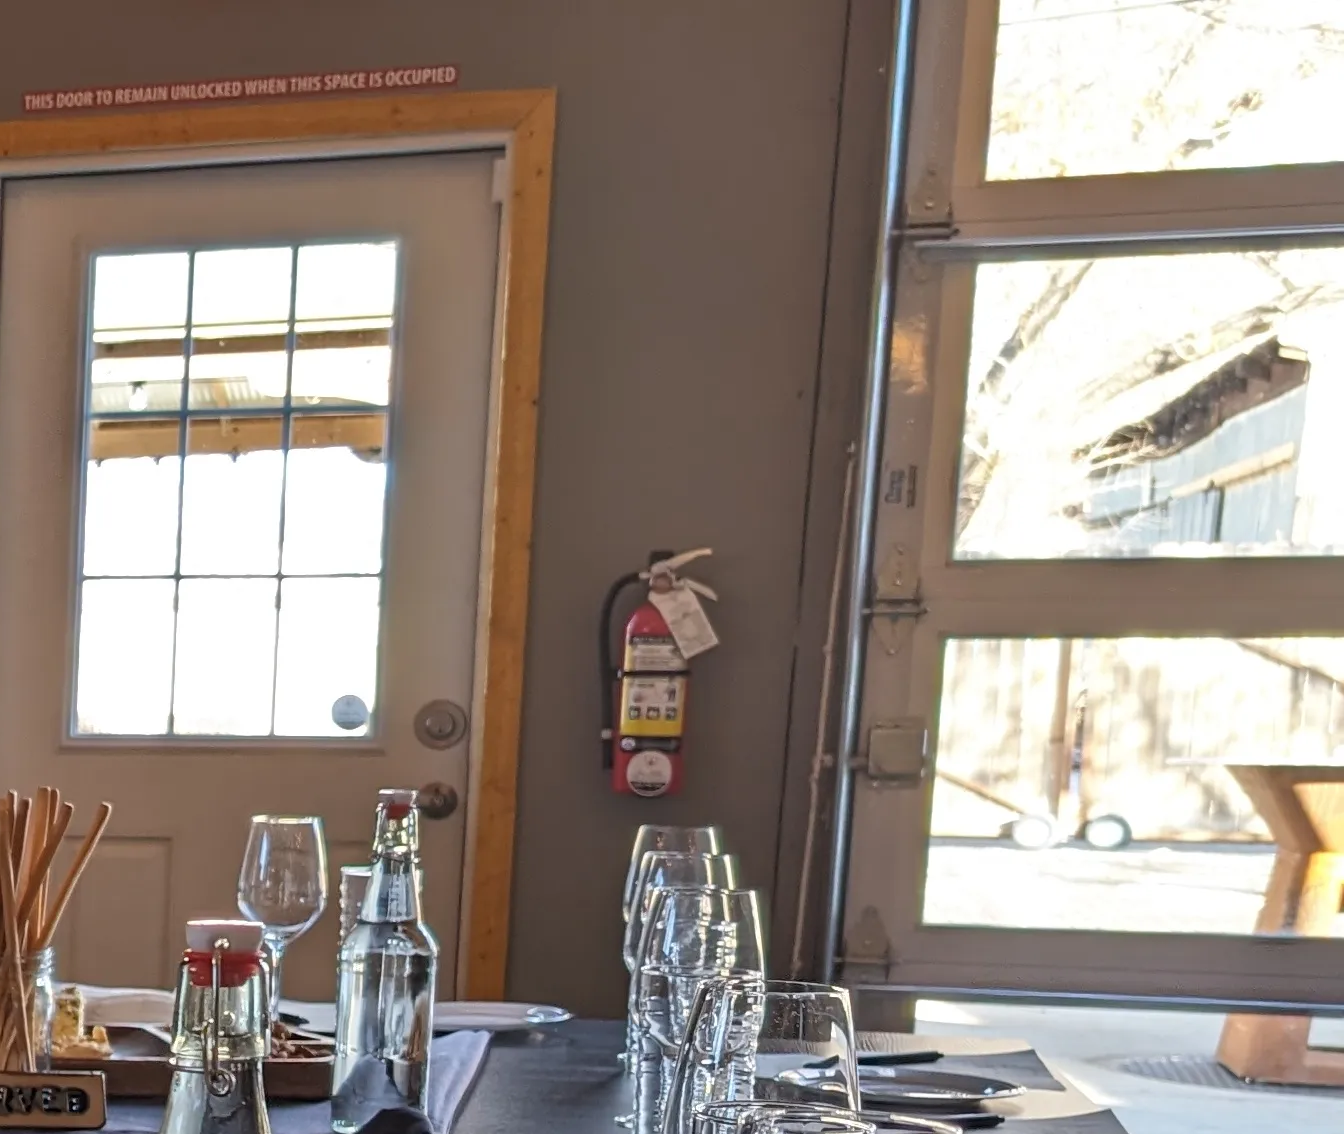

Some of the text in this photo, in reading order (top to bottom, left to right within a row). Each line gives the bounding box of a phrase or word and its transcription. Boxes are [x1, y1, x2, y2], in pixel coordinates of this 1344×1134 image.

[24, 66, 457, 110] THIS DOOR TO REMAIN UNLOCKED WHEN THIS SPACE IS OCCUPIED
